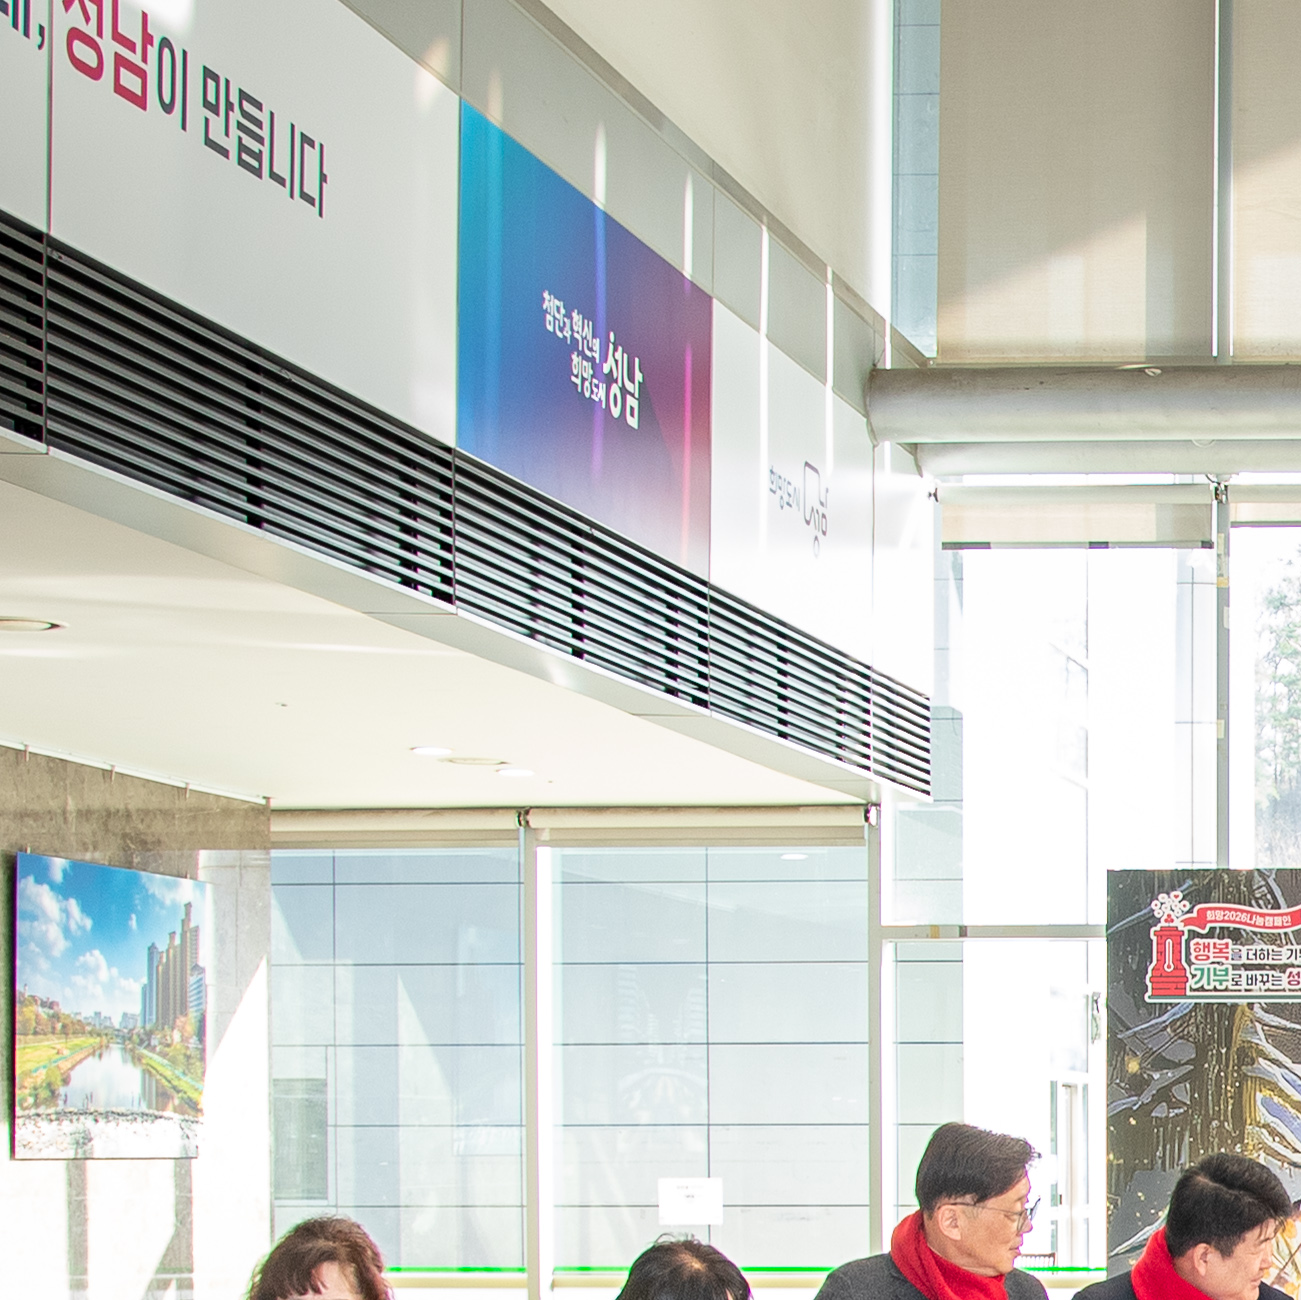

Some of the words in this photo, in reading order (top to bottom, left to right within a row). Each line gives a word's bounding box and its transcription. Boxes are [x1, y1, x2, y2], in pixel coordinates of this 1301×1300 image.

[202, 65, 328, 219] 만듭니다
[543, 290, 572, 344] 첨단과
[571, 309, 600, 364] 혁신의
[570, 351, 606, 409] 희망도시
[603, 331, 643, 430] 성남
[1192, 966, 1243, 986] 기부로
[1246, 974, 1283, 987] 바꾸는
[1193, 941, 1243, 962] 행복을
[1246, 948, 1283, 962] 더하는
